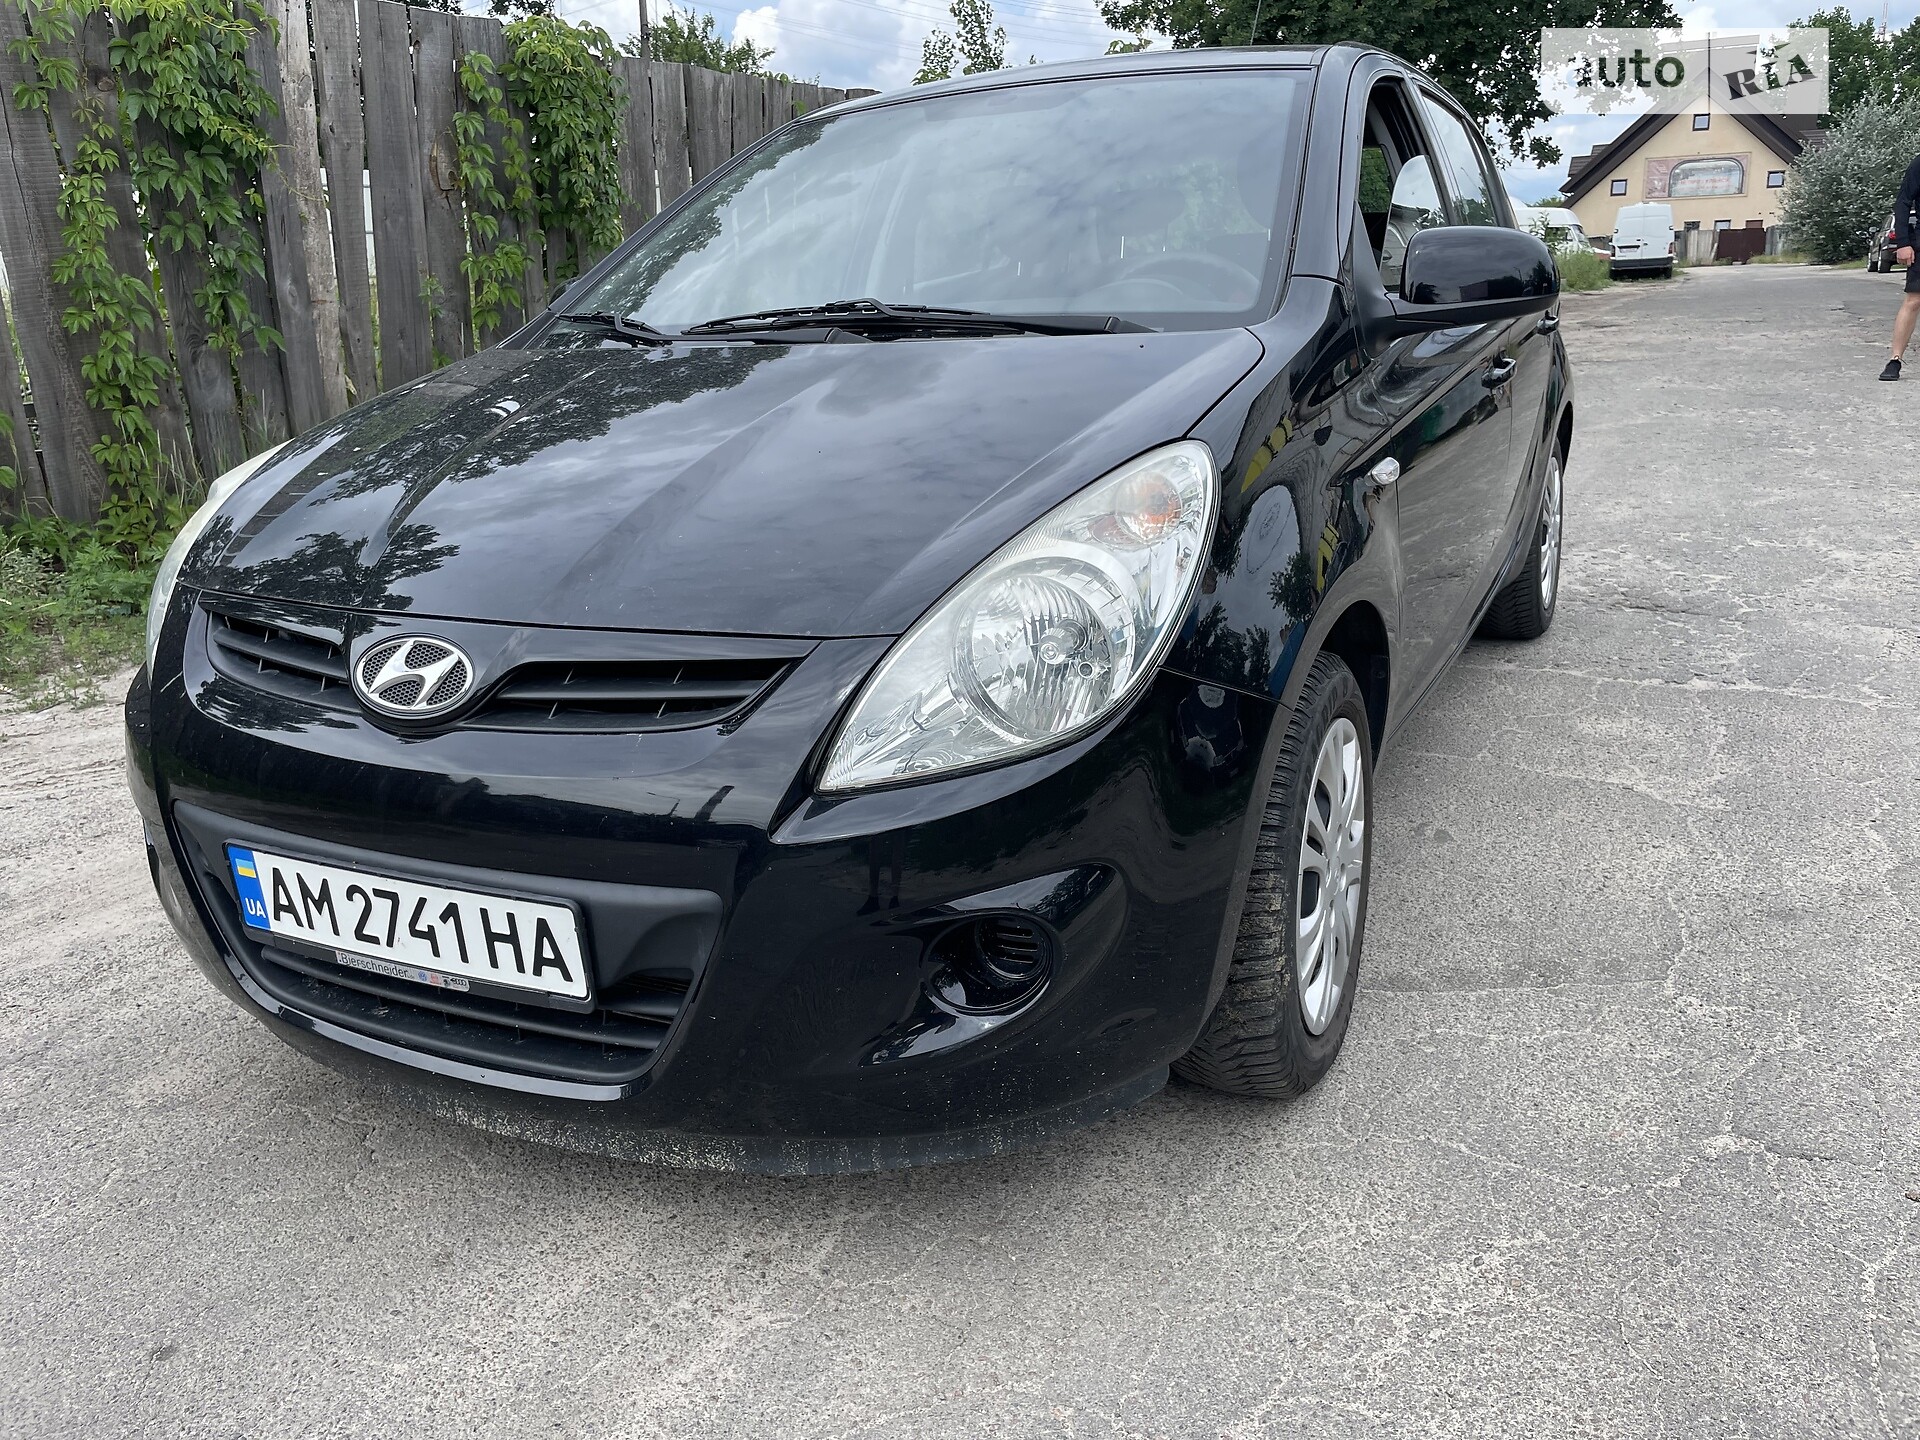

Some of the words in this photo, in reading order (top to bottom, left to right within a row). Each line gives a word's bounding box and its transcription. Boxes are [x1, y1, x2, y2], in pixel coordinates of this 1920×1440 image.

[245, 896, 267, 919] UA
[272, 867, 340, 937] AM
[345, 883, 469, 964] 2741
[479, 907, 574, 983] HA
